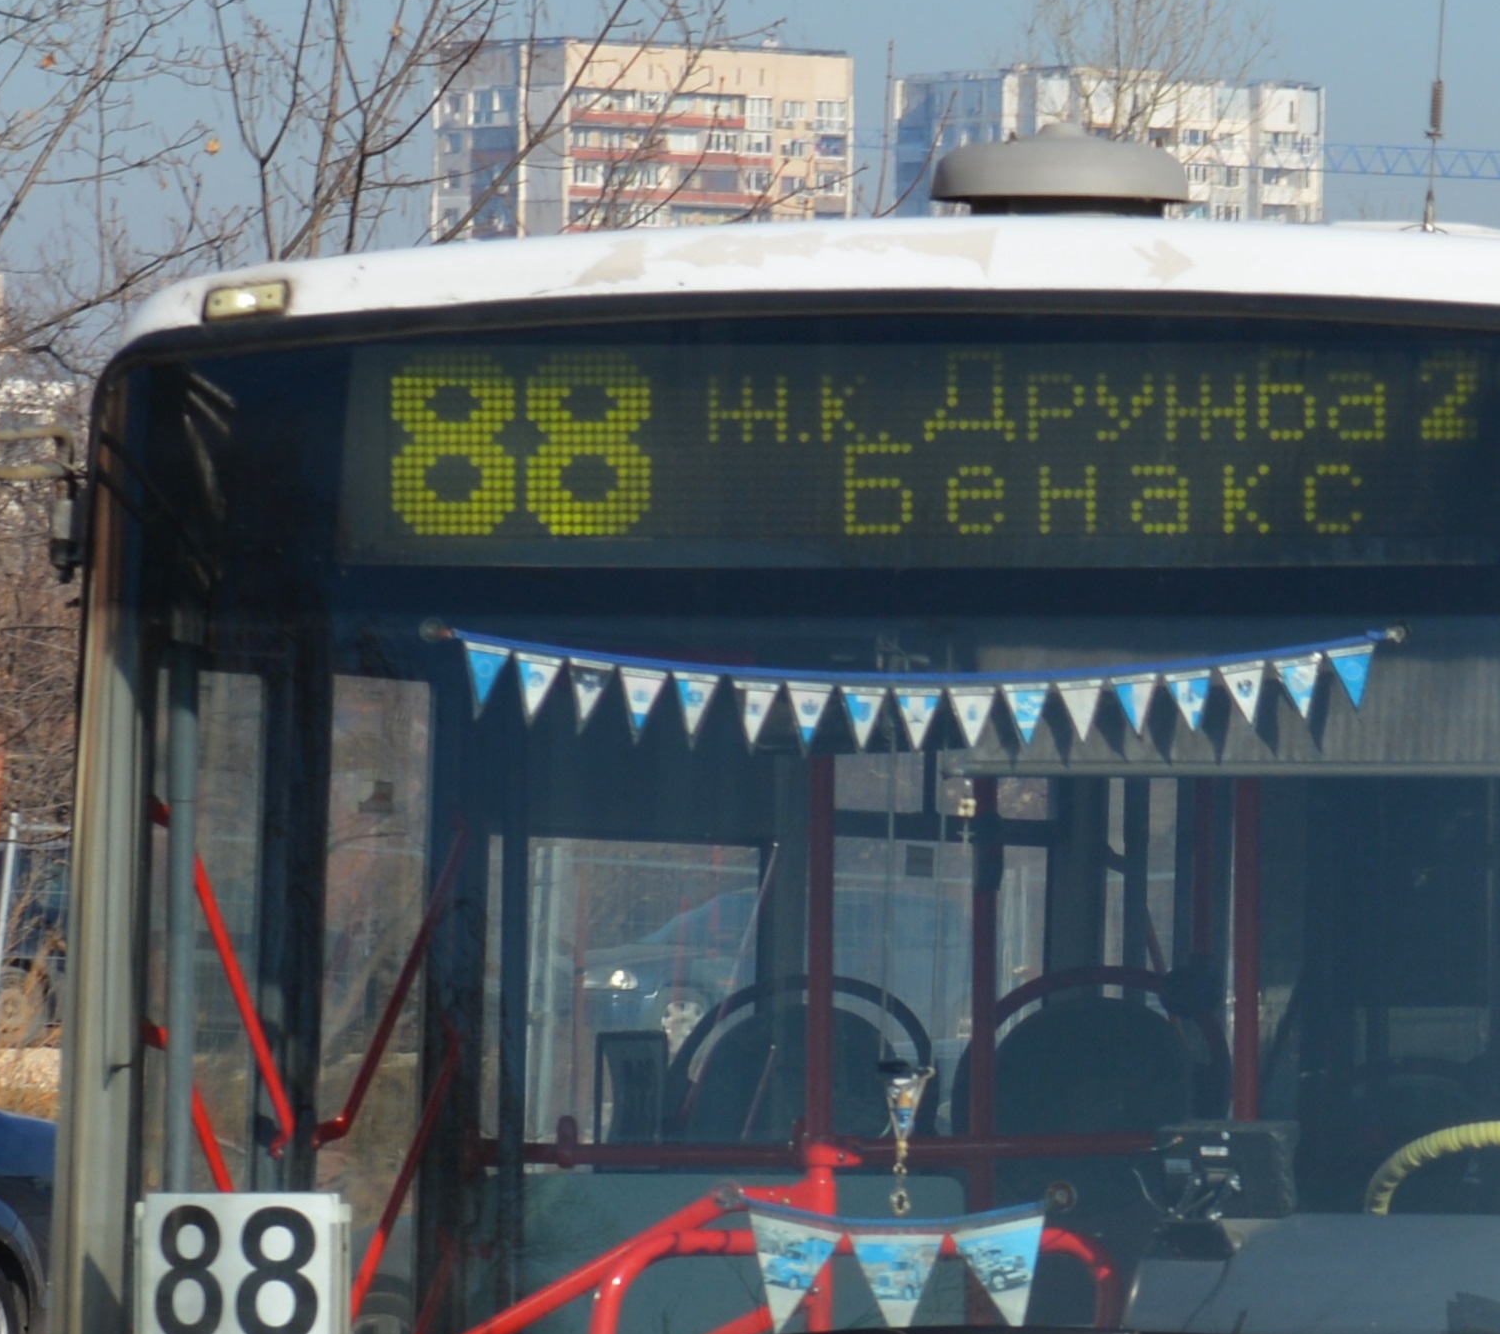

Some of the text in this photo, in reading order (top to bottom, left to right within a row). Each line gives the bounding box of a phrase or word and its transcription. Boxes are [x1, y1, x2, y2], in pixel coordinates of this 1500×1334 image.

[924, 349, 1388, 442] Дружба
[1420, 348, 1480, 442] 2
[391, 351, 651, 535] 88
[844, 443, 1364, 536] Бенакс
